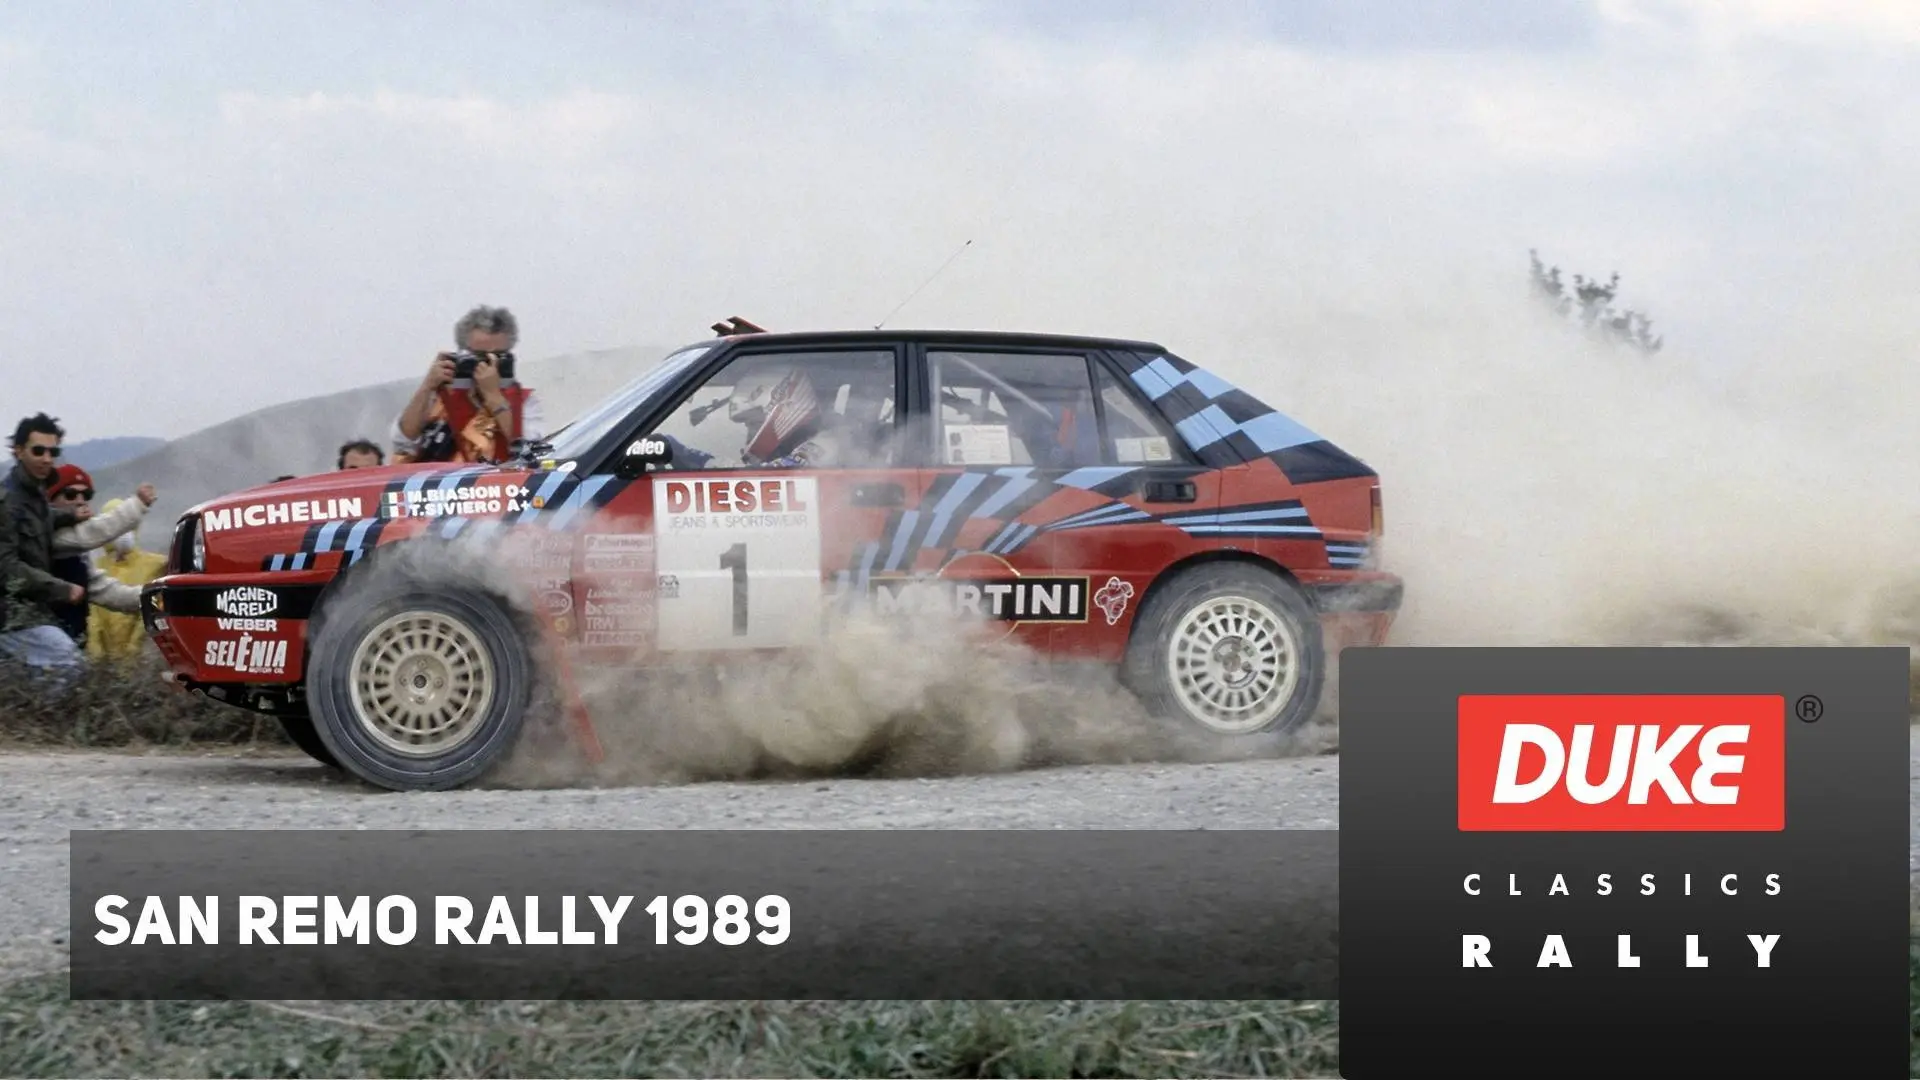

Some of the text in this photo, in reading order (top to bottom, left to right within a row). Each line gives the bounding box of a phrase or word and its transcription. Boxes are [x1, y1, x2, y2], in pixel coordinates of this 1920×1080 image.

[407, 484, 529, 503] M.BIASION O+
[666, 481, 806, 513] DIESEL
[205, 498, 362, 533] MICHELIN
[410, 499, 530, 517] T.SIVIERO A+
[668, 515, 706, 529] JEANS
[725, 514, 808, 528] SPORTSWEAR
[217, 587, 277, 603] MAGNETI
[719, 543, 748, 636] 1
[217, 618, 277, 632] WEBER
